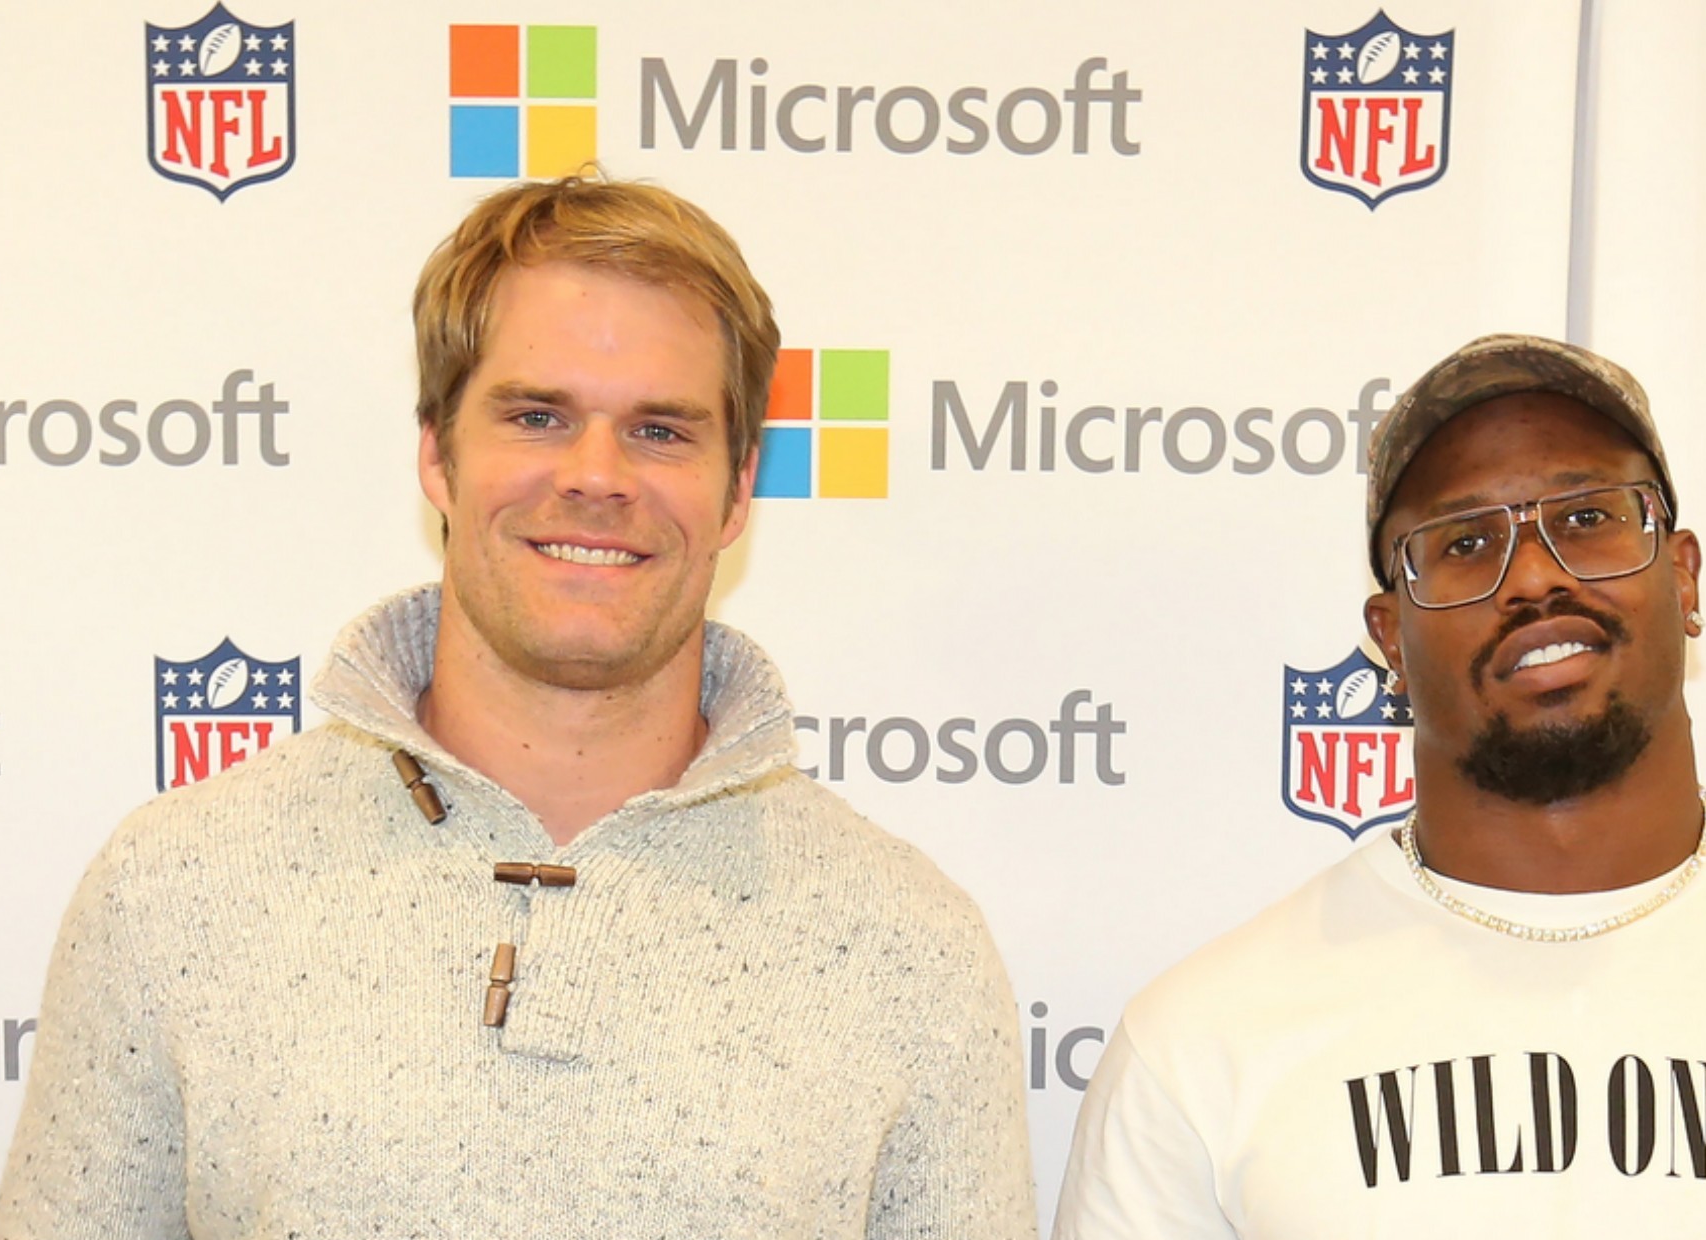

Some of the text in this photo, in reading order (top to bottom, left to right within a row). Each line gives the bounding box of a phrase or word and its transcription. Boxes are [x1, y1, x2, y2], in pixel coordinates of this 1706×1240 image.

[162, 90, 281, 176] NFL
[641, 57, 1142, 155] Microsoft
[1316, 98, 1434, 185] NFL
[932, 378, 1389, 476] Microsof
[797, 690, 1126, 785] crosoft
[1344, 1050, 1578, 1189] WILD
